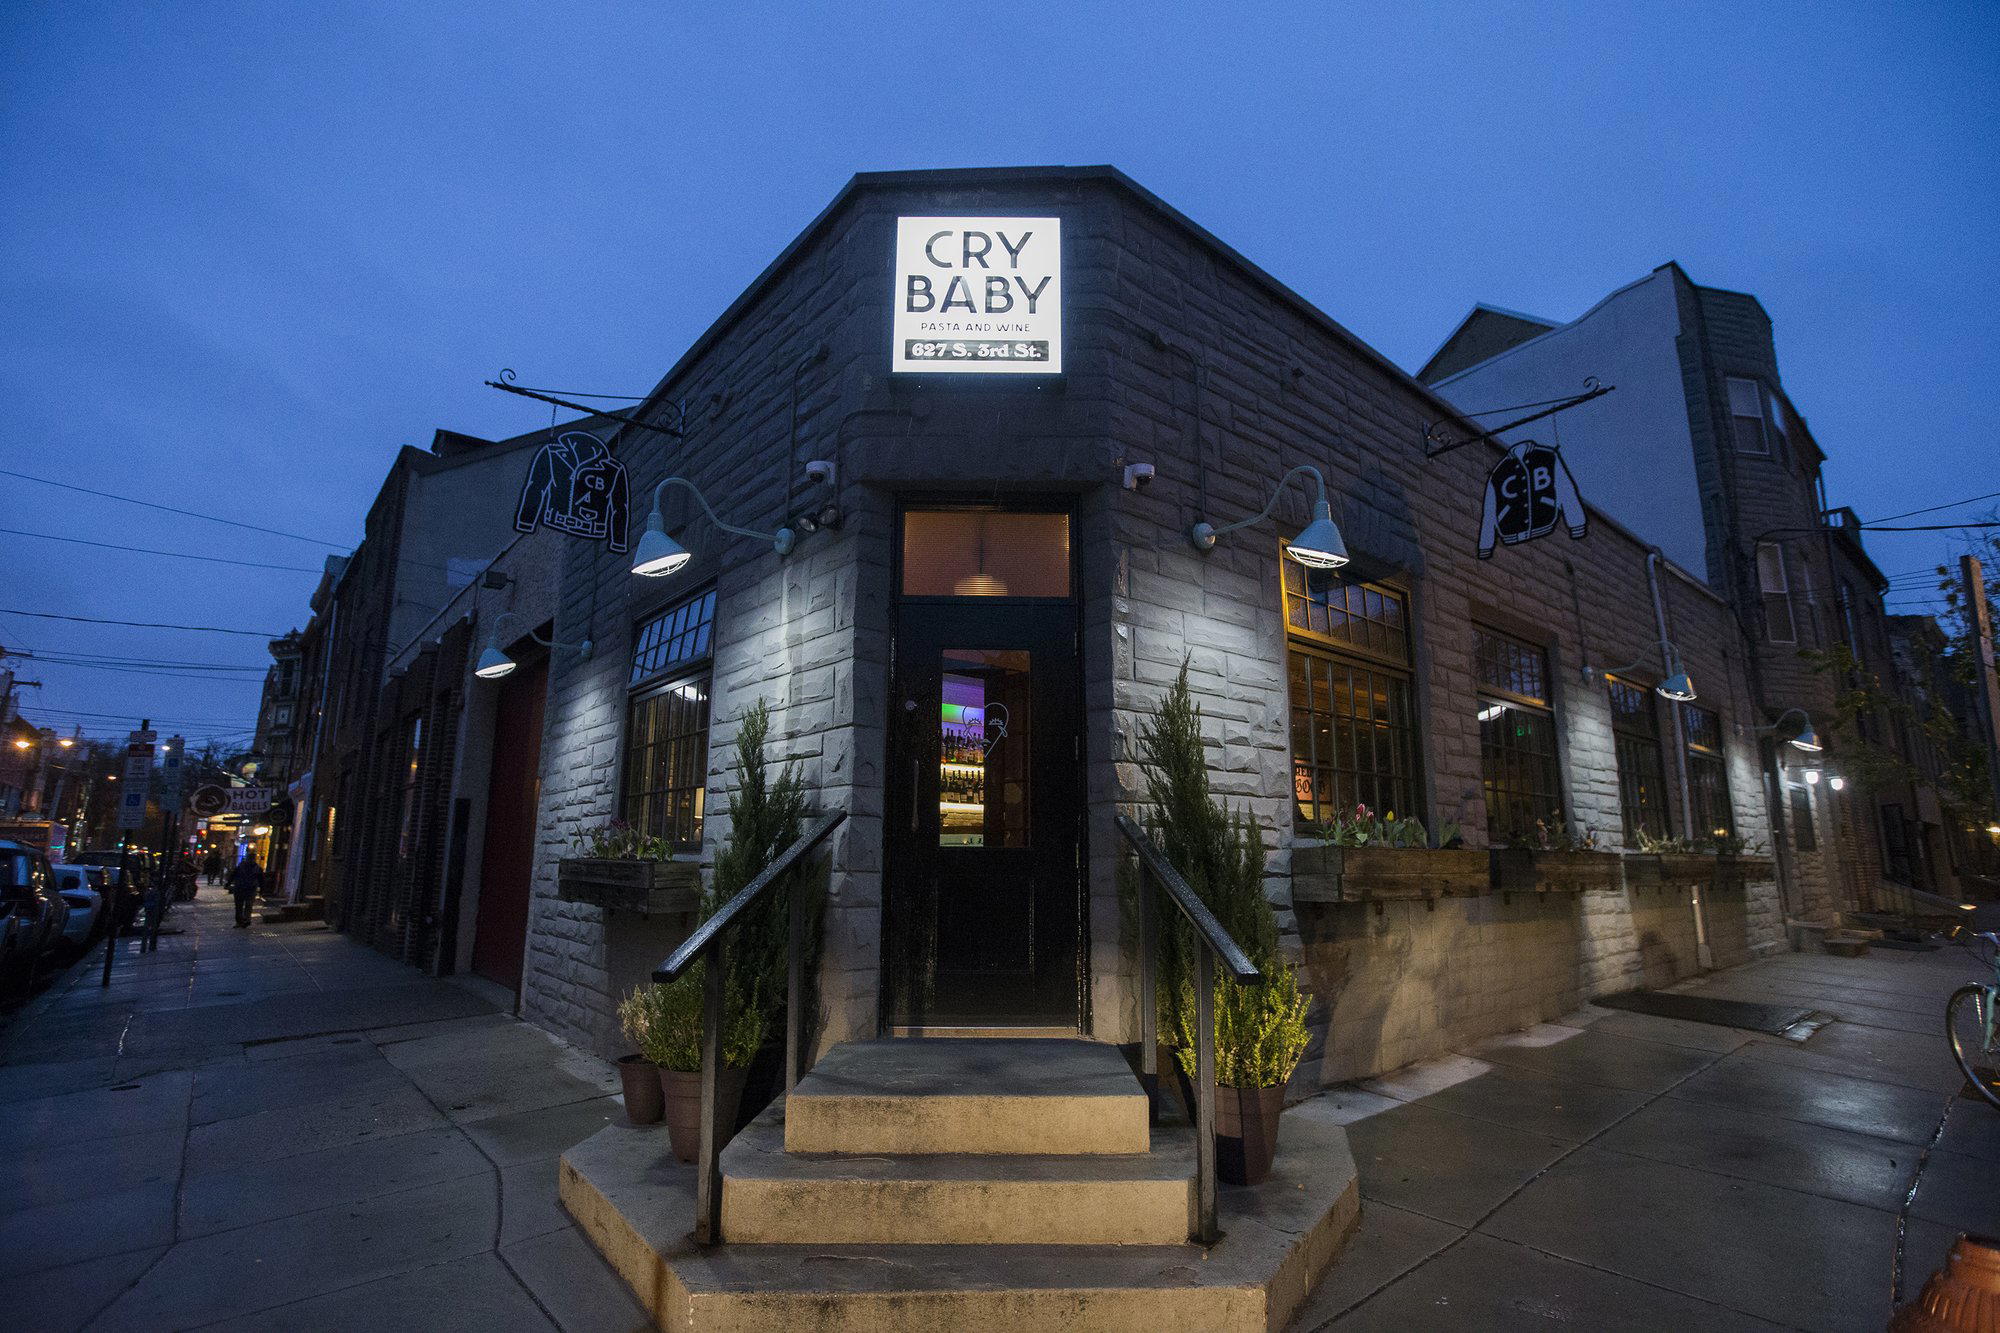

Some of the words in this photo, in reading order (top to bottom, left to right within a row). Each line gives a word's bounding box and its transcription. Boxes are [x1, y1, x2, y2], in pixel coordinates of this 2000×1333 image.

[925, 230, 1033, 269] CRY
[906, 274, 1052, 314] BABY
[921, 322, 960, 332] PASTA
[965, 322, 991, 332] AND
[997, 323, 1031, 332] WINE
[912, 342, 949, 357] 627
[952, 343, 972, 357] S.
[978, 343, 1010, 358] 3rd
[1014, 343, 1042, 358] St.
[584, 474, 605, 491] CB
[233, 789, 268, 799] HOT
[232, 801, 268, 811] BAGELS
